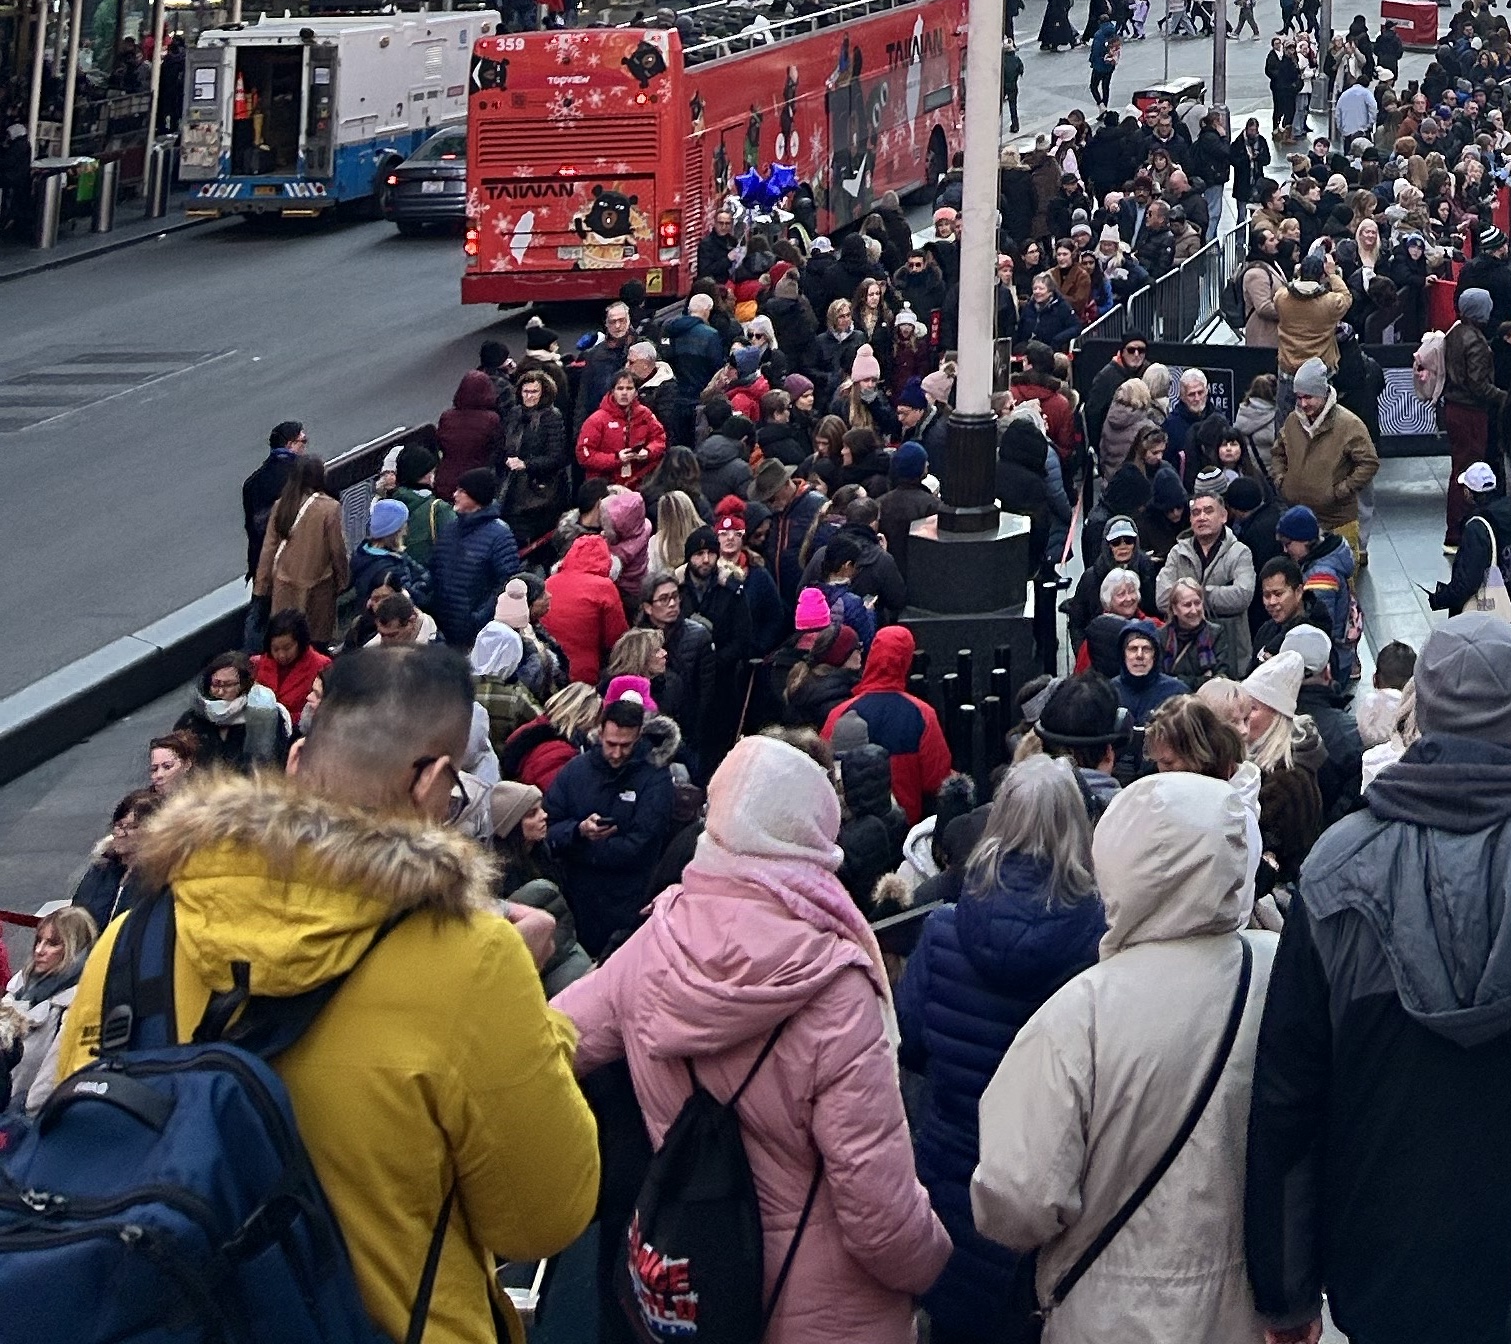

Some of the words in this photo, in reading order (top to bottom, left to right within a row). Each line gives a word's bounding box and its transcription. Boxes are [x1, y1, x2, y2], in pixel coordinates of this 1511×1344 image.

[496, 38, 525, 52] 359
[886, 27, 943, 71] TAIWAN
[485, 183, 574, 200] TAIWAN
